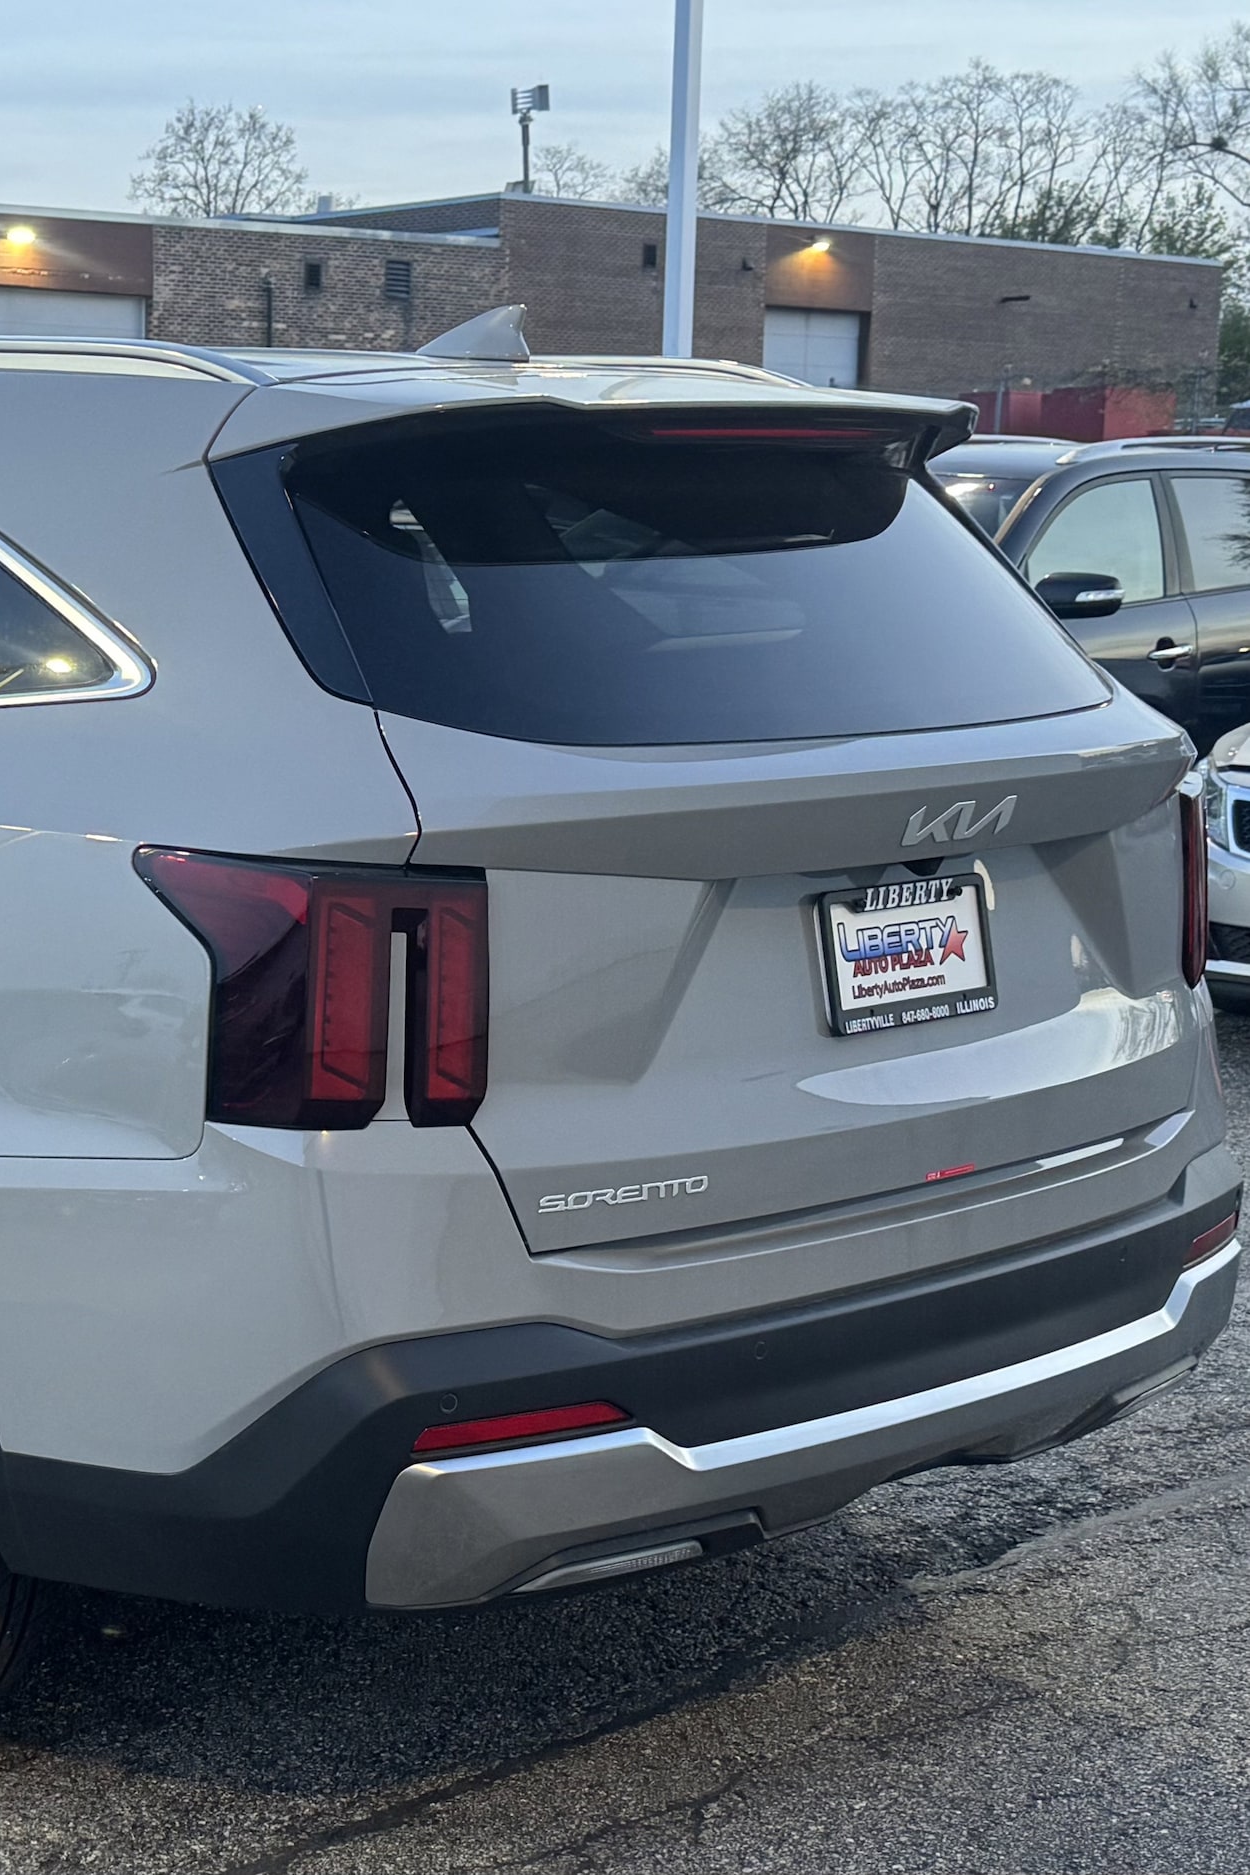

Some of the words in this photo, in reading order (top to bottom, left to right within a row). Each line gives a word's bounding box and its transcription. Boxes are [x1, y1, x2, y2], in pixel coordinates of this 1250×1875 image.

[864, 878, 953, 911] LIBERTY
[837, 916, 956, 962] LIBERTY
[853, 955, 889, 978] AUTO
[891, 948, 934, 971] PLAZA
[852, 974, 946, 999] LibertyAutoPlaza.com
[845, 1013, 895, 1034] LIBERTYVILLE
[955, 996, 996, 1014] ILLINOIS
[538, 1175, 709, 1213] SORENTO
